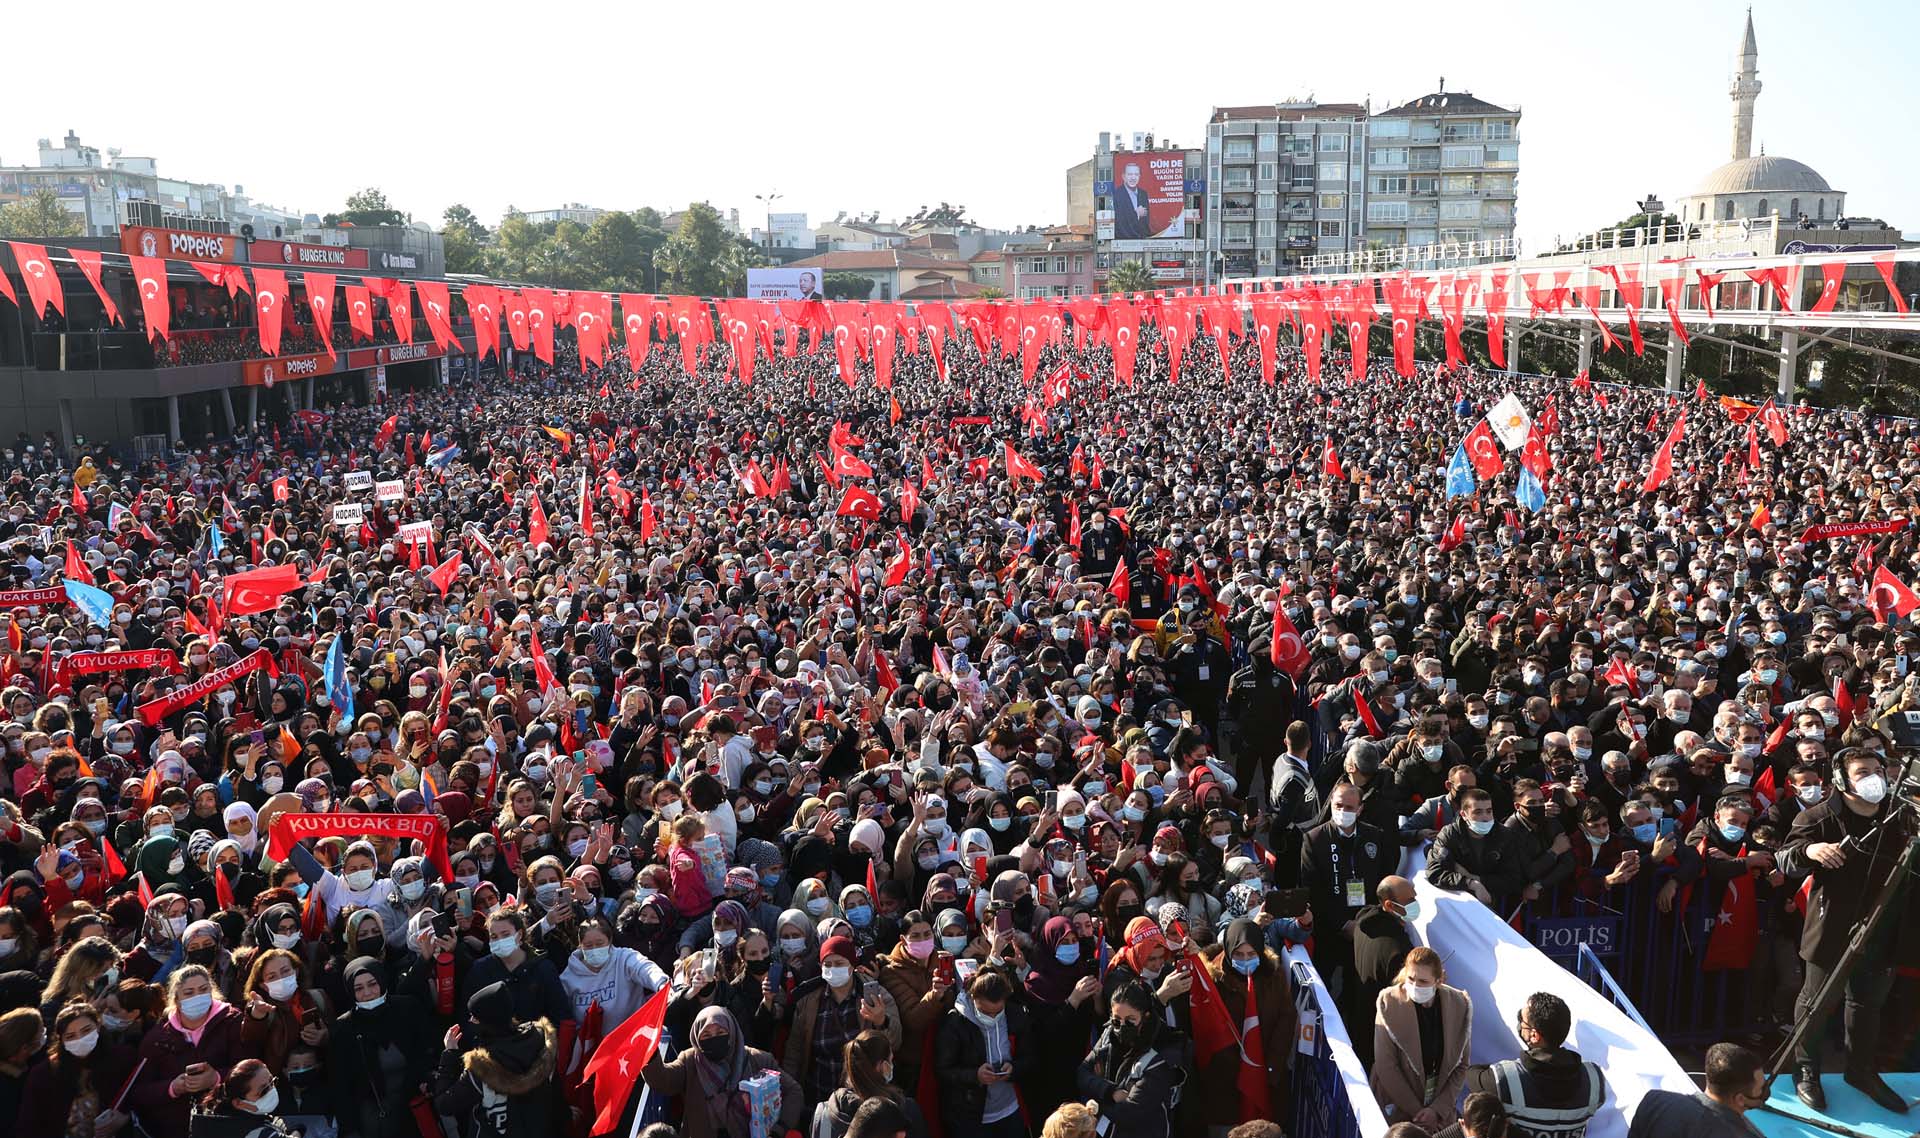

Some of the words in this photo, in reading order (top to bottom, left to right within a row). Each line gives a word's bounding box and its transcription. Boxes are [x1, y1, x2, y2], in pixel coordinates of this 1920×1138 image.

[1150, 159, 1170, 168] DÜN
[300, 248, 327, 263] BURGER
[328, 251, 345, 264] KING
[390, 346, 413, 361] BURGER
[414, 345, 428, 358] KING
[1818, 524, 1868, 533] KUYUCAK
[1871, 521, 1892, 529] BLD
[33, 590, 57, 600] BLD
[67, 654, 138, 668] KUYUCAK
[143, 652, 170, 664] BLD
[167, 671, 231, 704] KUYUCAK
[234, 657, 257, 675] BLD
[289, 817, 391, 833] KUYUCAK
[397, 818, 434, 836] BLD
[1540, 924, 1610, 947] POLİS
[576, 981, 615, 1006] mavi
